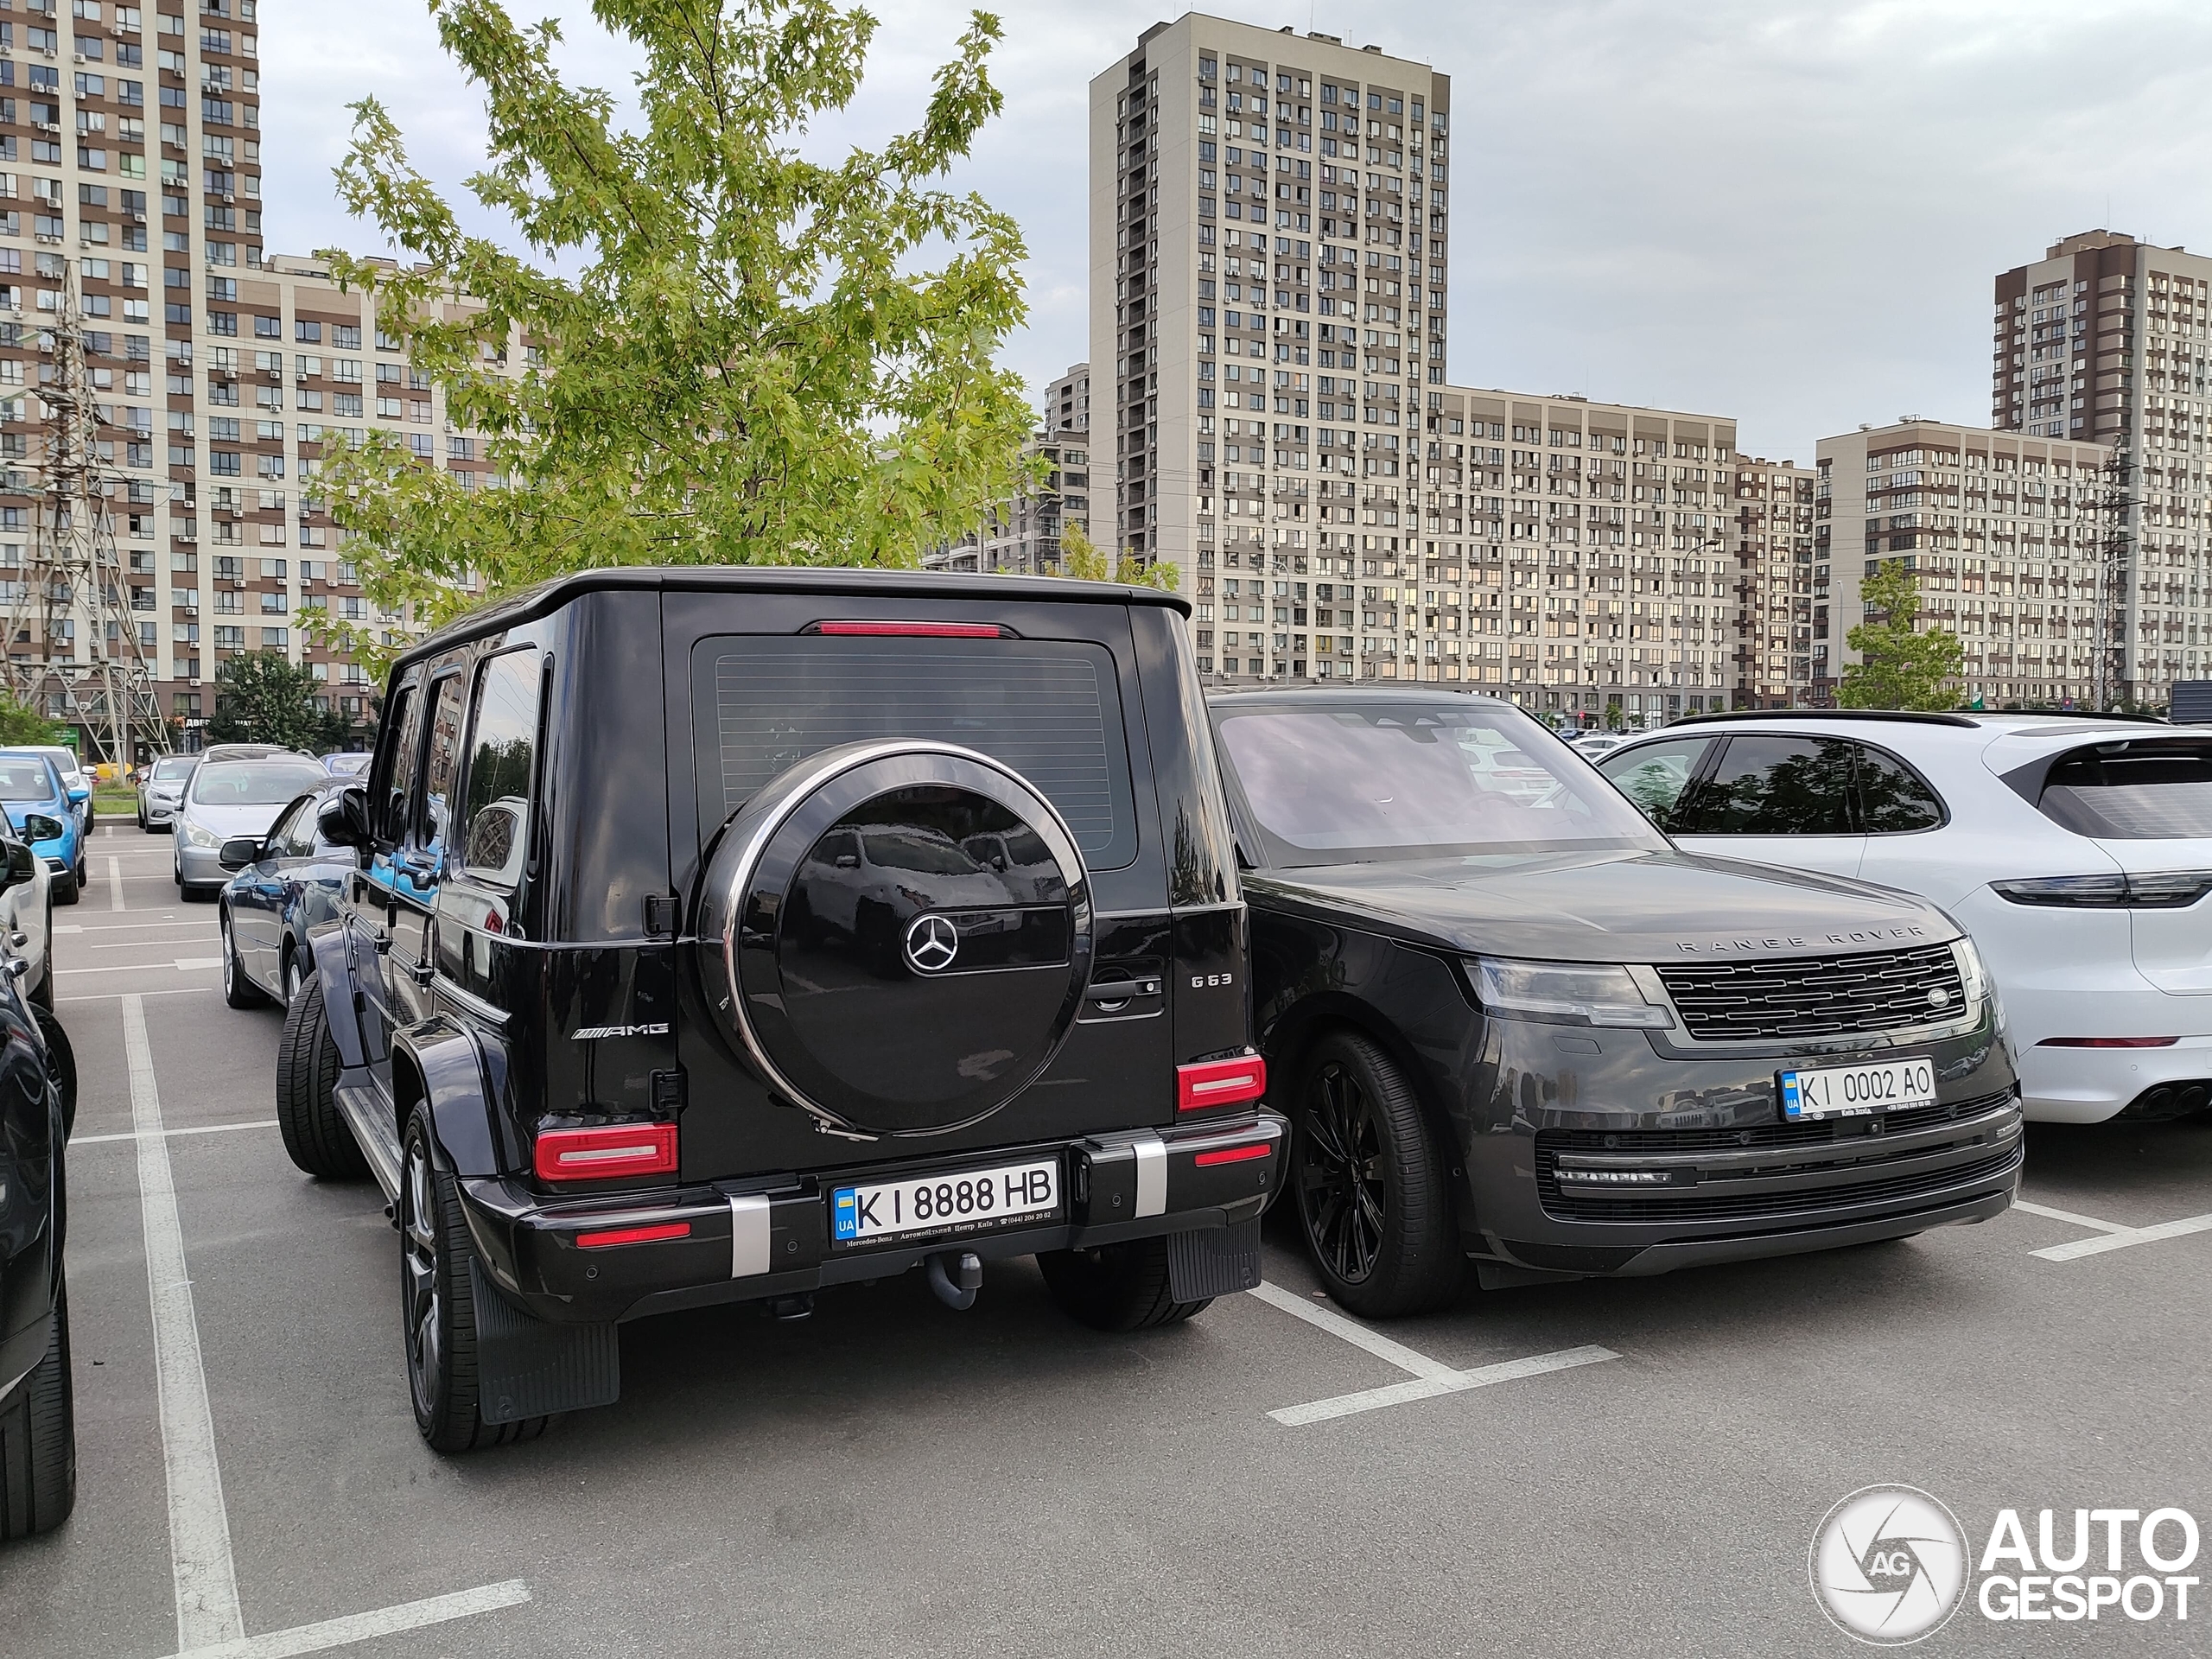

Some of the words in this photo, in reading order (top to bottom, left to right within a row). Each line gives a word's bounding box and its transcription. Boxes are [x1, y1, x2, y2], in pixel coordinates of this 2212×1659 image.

[1675, 936, 1807, 952] RANGE
[1826, 926, 1925, 944] ROVER
[1192, 976, 1204, 988] G
[1207, 973, 1232, 987] 63
[602, 1023, 670, 1038] AMG
[1800, 1076, 1831, 1108] KI
[1843, 1070, 1897, 1103] 0002
[1904, 1065, 1929, 1096] AO
[1787, 1099, 1800, 1109] UA
[857, 1189, 901, 1230] KI
[913, 1178, 995, 1221] 8888
[1004, 1169, 1052, 1208] HB
[838, 1219, 855, 1232] UA
[1007, 1215, 1023, 1225] (044)
[1024, 1213, 1035, 1222] 206
[1043, 1211, 1052, 1219] 02
[846, 1235, 893, 1248] Mercedes-Benz
